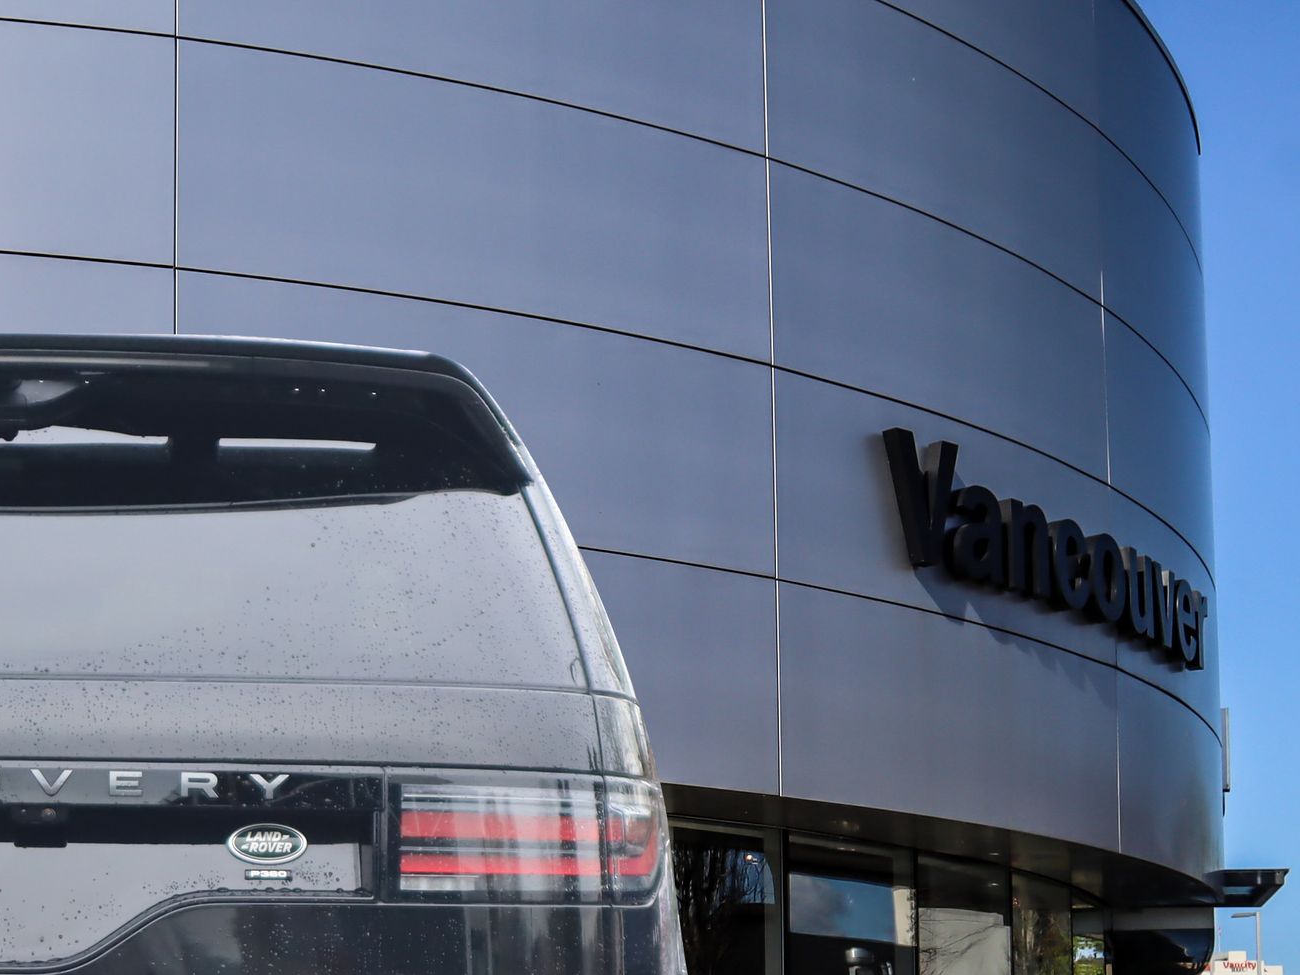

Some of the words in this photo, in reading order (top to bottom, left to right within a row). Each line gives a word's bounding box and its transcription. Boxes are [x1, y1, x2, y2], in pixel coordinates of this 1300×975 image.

[883, 427, 1207, 671] Vancouver
[245, 831, 282, 842] LAND
[249, 842, 292, 853] ROVER
[1223, 961, 1257, 971] Vancity
